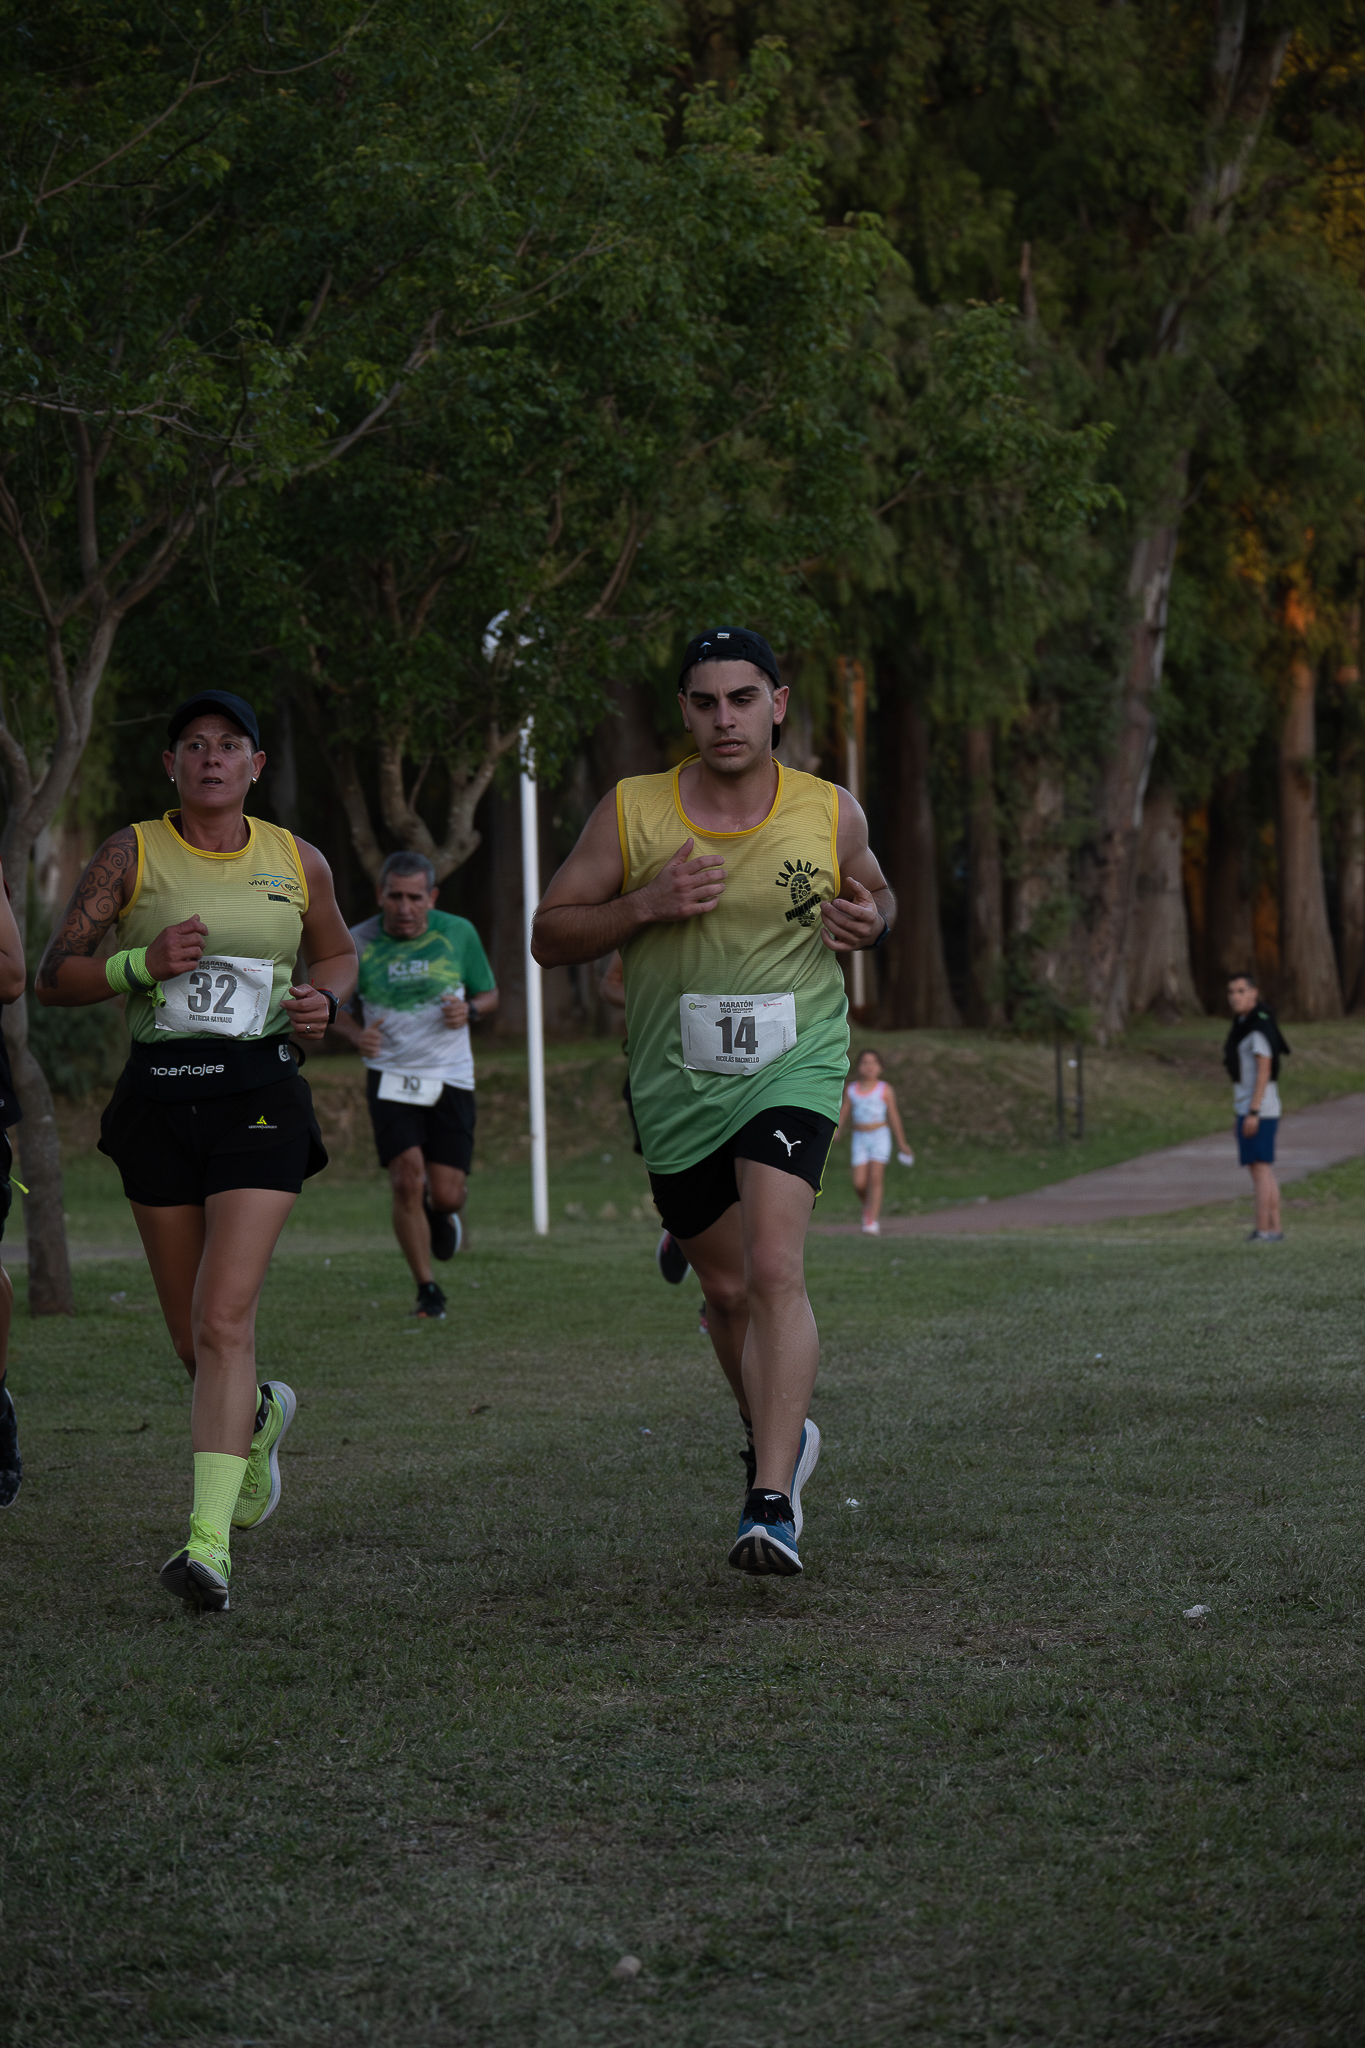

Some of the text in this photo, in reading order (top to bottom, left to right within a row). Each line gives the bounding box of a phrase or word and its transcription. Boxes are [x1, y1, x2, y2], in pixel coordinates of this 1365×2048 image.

[785, 894, 822, 922] RUNNING
[187, 971, 238, 1015] 32
[719, 1000, 754, 1008] MARATÓN
[715, 1016, 759, 1055] 14
